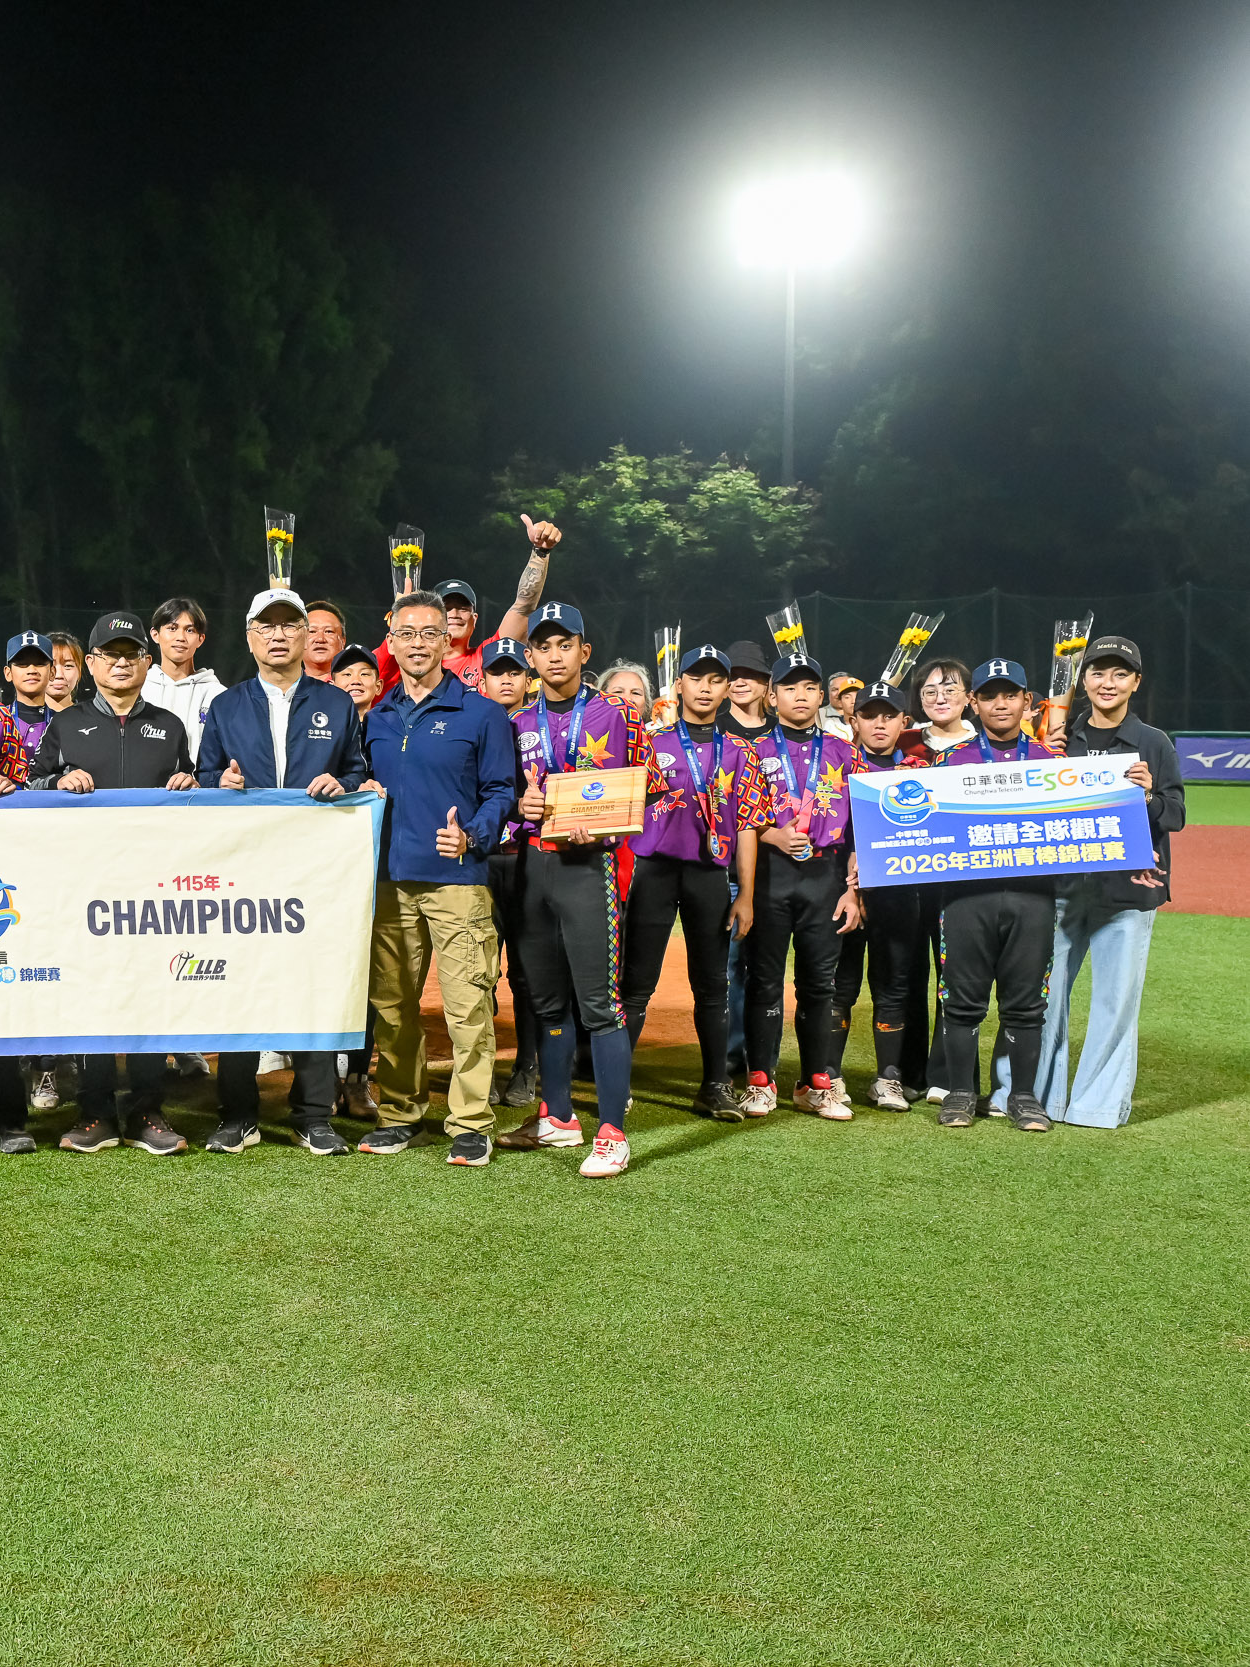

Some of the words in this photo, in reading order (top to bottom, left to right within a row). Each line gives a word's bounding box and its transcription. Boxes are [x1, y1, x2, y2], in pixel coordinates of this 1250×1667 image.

[541, 603, 562, 621] H
[21, 632, 39, 647] H
[496, 639, 516, 655] H
[699, 645, 717, 659] H
[789, 653, 808, 668] H
[988, 660, 1010, 677] H
[869, 683, 890, 698] H
[963, 773, 1023, 788] 中華電信
[1025, 768, 1078, 791] ESG
[964, 788, 997, 796] Chunghwa
[570, 804, 615, 814] CHAMPIONS
[967, 816, 1123, 847] 邀請全隊觀賞
[885, 842, 1126, 876] 2026年亞洲青棒錦標賽
[173, 875, 221, 892] 115年
[87, 898, 306, 936] CHAMPIONS
[20, 967, 61, 982] 錦標賽
[187, 959, 227, 975] TLLB
